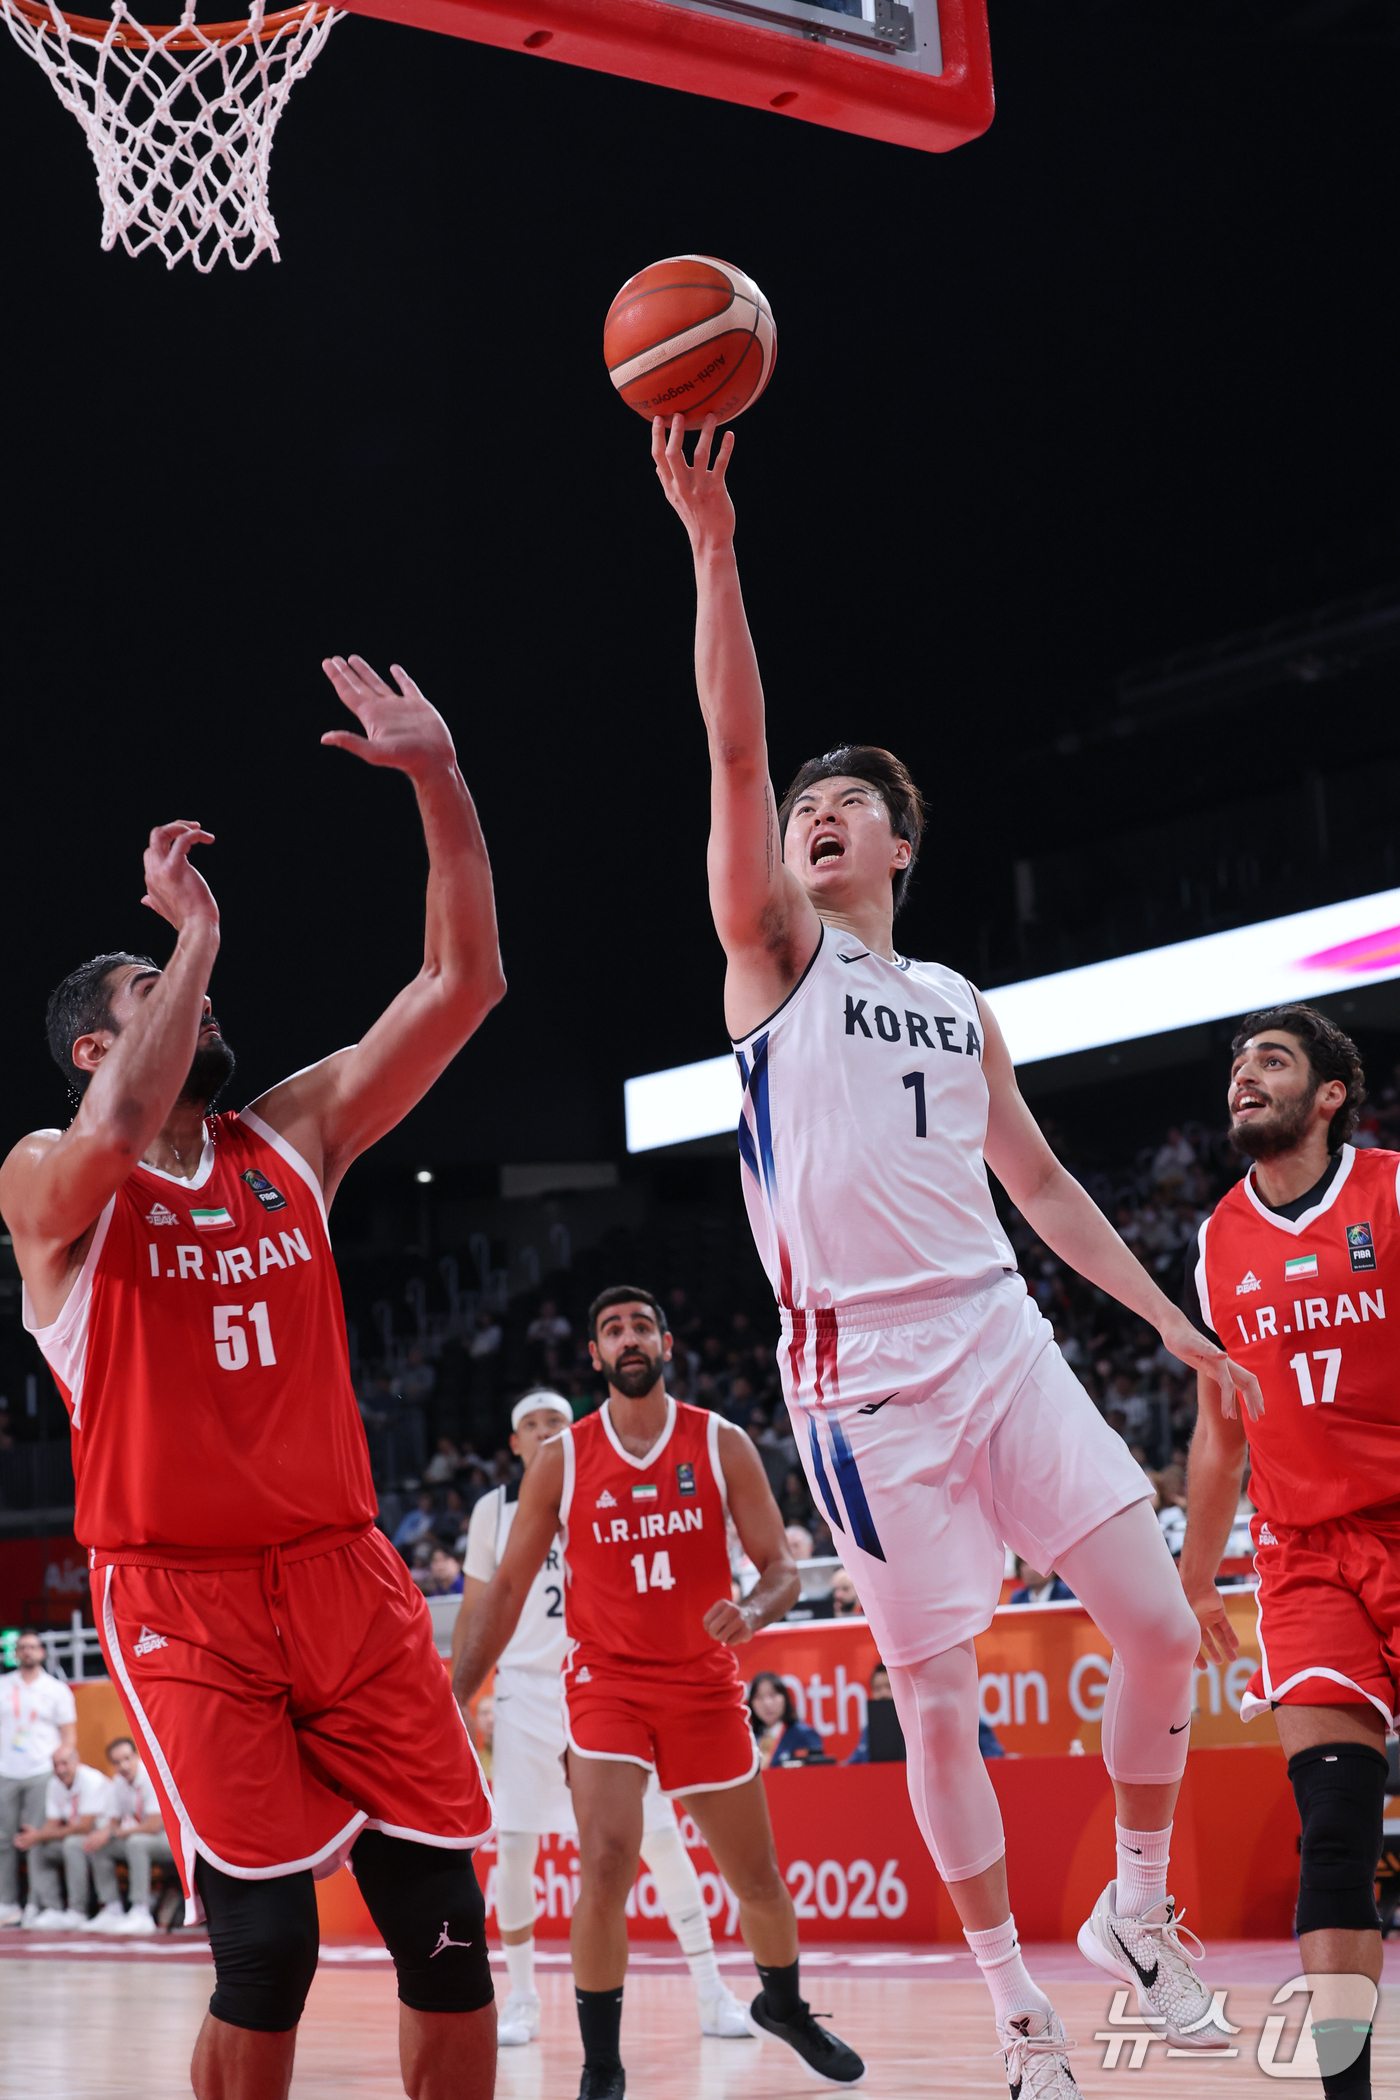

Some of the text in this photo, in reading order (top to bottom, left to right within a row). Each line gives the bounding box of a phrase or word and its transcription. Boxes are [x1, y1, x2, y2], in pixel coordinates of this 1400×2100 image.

[652, 353, 726, 405] Aichi-Nagoya
[843, 994, 981, 1064] KOREA
[902, 1071, 927, 1138] 1
[1353, 1248, 1371, 1260] FIBA
[1236, 1280, 1262, 1296] PEAK
[213, 1301, 277, 1371] 51
[1236, 1288, 1386, 1345] I.R.IRAN
[1289, 1348, 1342, 1407] 17
[630, 1550, 676, 1594] 14
[545, 1585, 563, 1618] 2
[133, 1636, 169, 1658] PEAK
[786, 1858, 908, 1920] 2026
